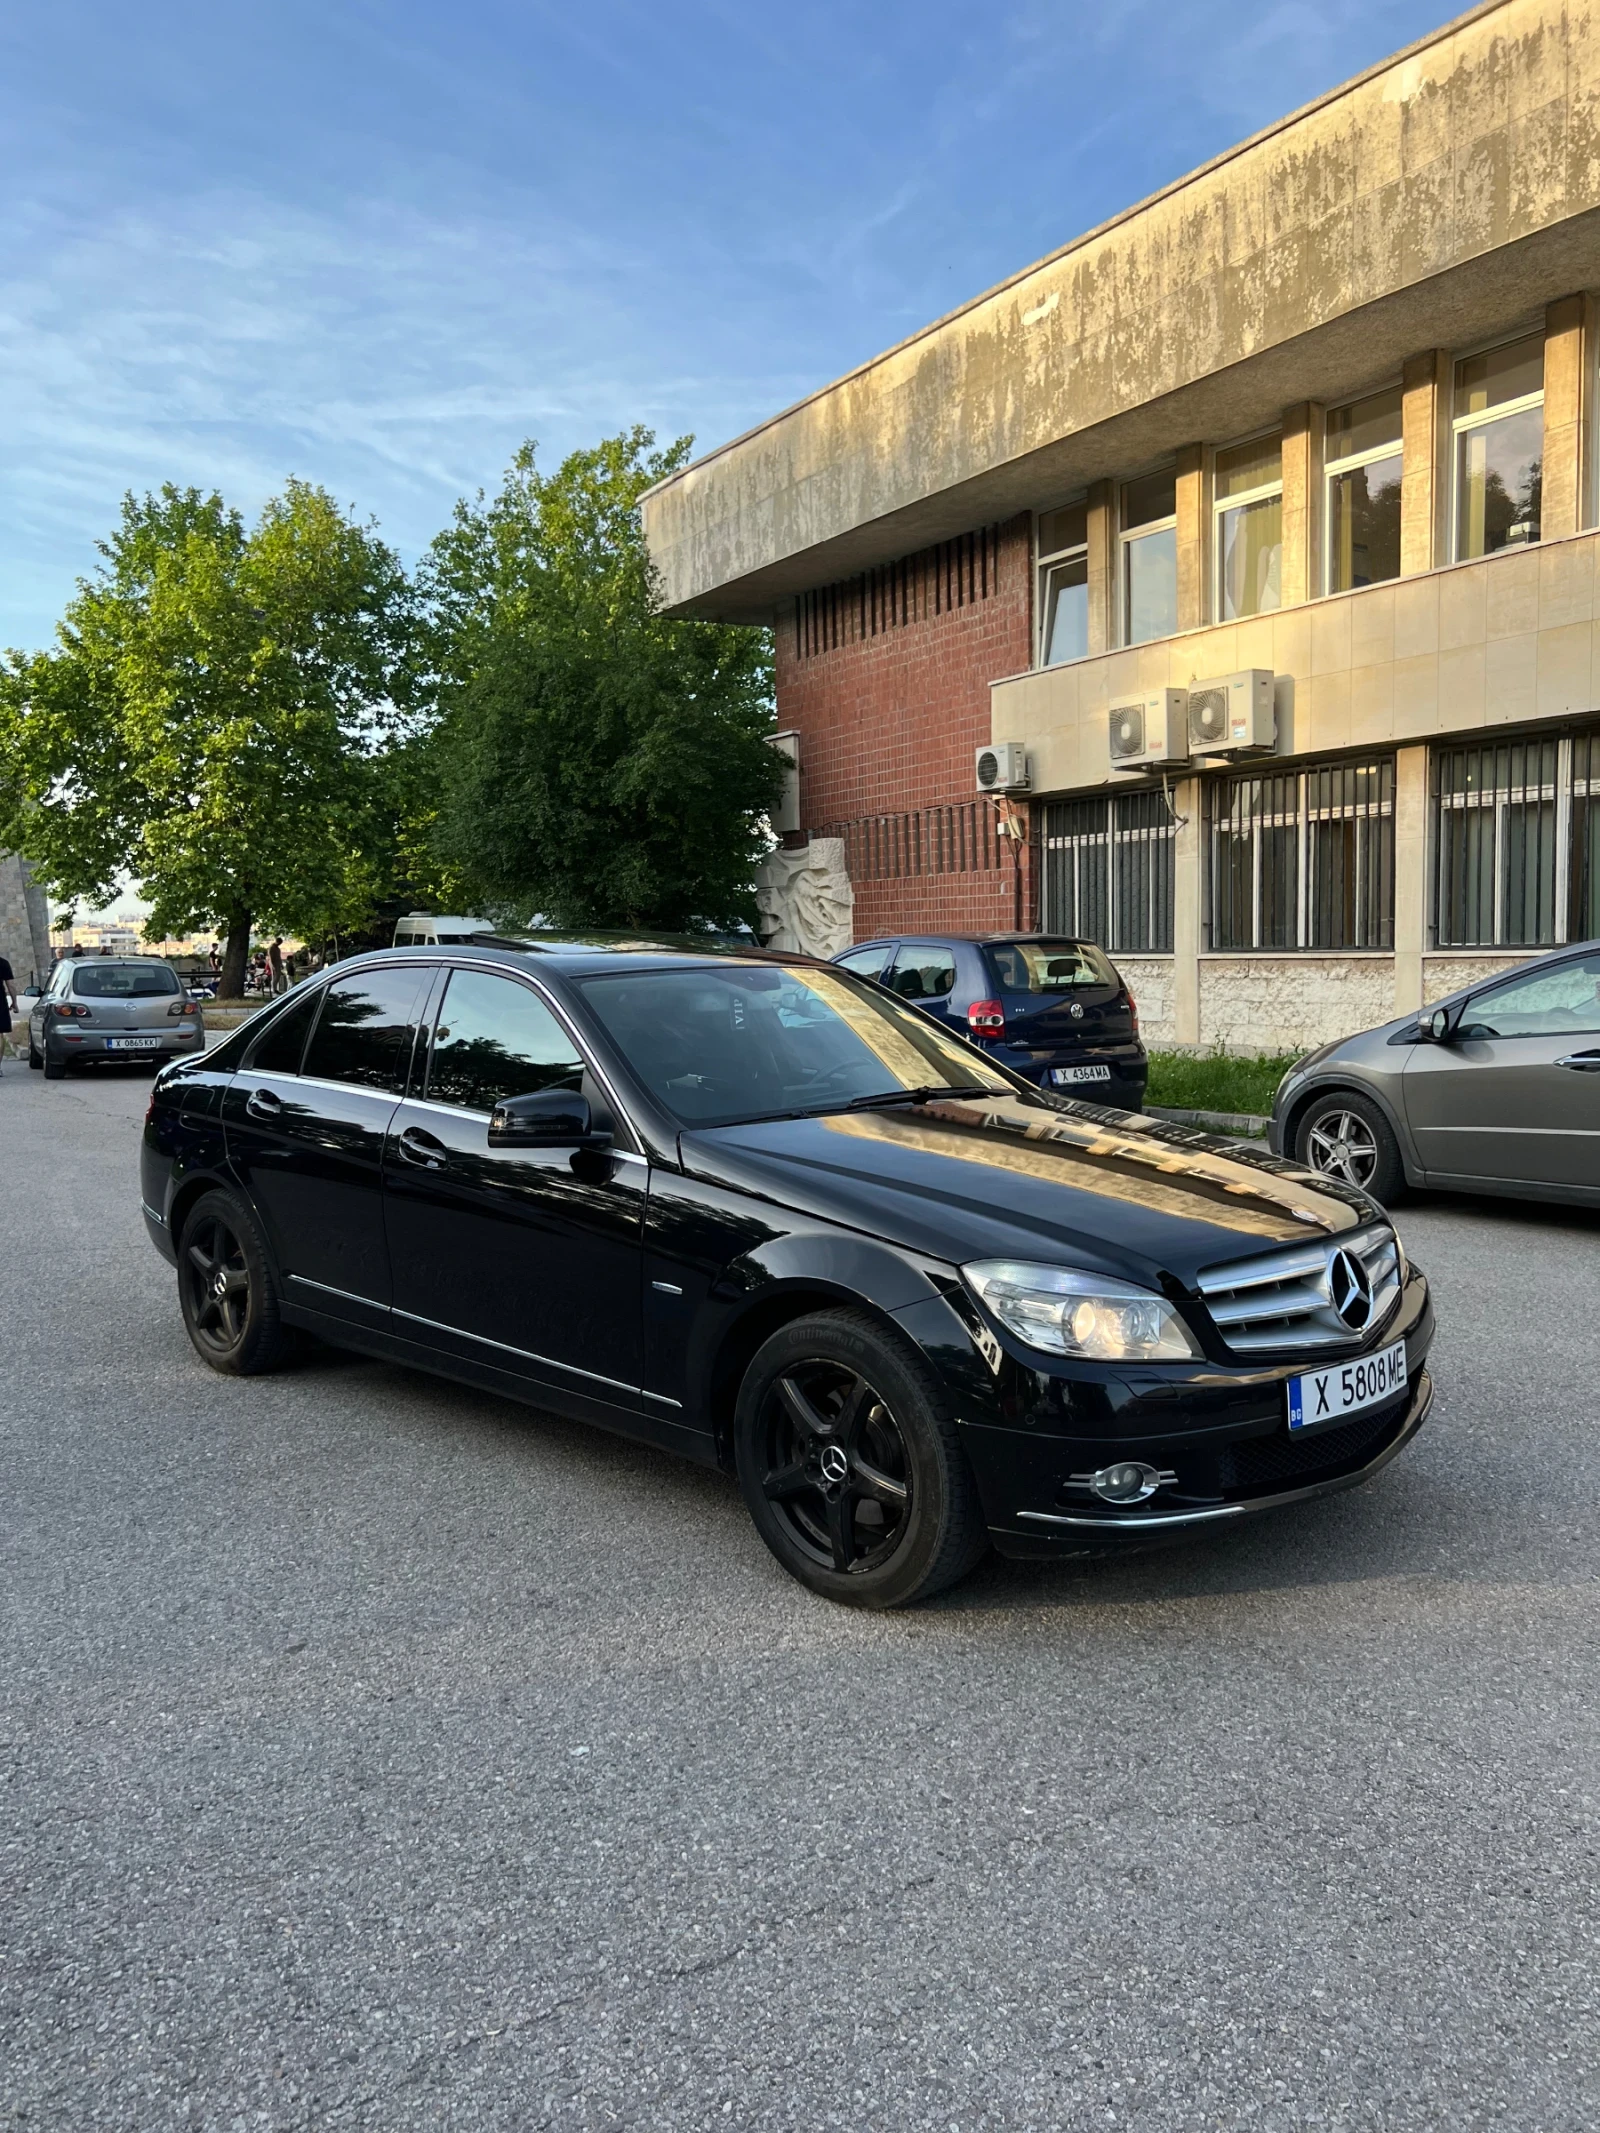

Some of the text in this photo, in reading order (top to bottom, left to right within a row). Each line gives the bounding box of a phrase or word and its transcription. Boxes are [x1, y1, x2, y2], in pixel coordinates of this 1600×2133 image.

[1060, 1069, 1069, 1082] X
[1315, 1375, 1329, 1415] X
[1291, 1408, 1302, 1421] BG
